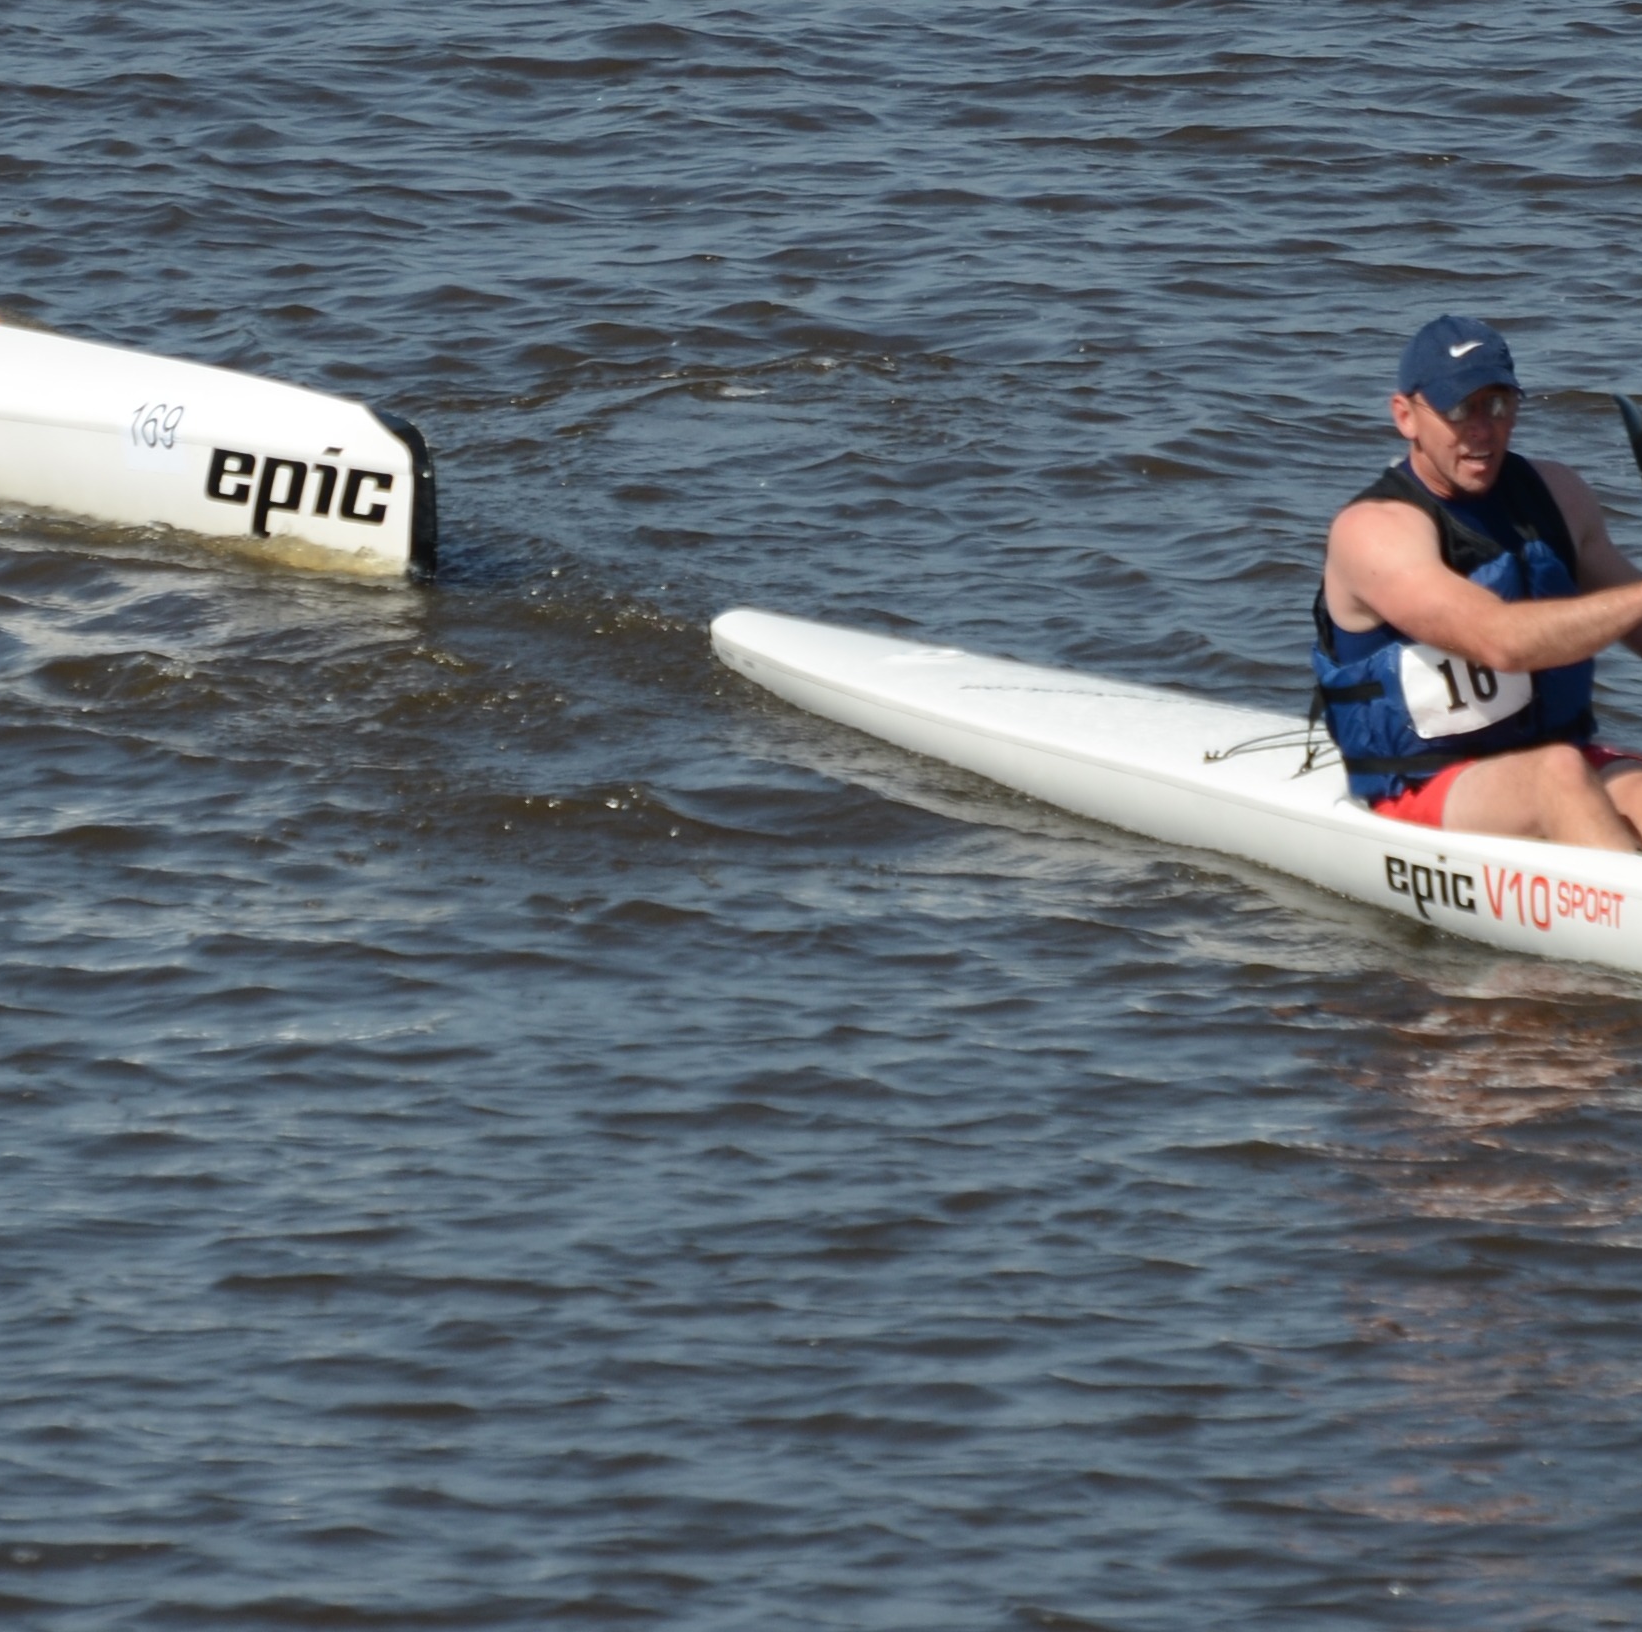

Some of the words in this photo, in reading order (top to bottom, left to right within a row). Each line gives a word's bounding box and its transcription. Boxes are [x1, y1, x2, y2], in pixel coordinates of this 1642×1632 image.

[131, 403, 185, 449] 169
[205, 446, 393, 538] epic
[1437, 659, 1498, 713] 16
[1385, 854, 1476, 919] epic
[1483, 864, 1551, 931] V10
[1557, 880, 1624, 928] SPORT
